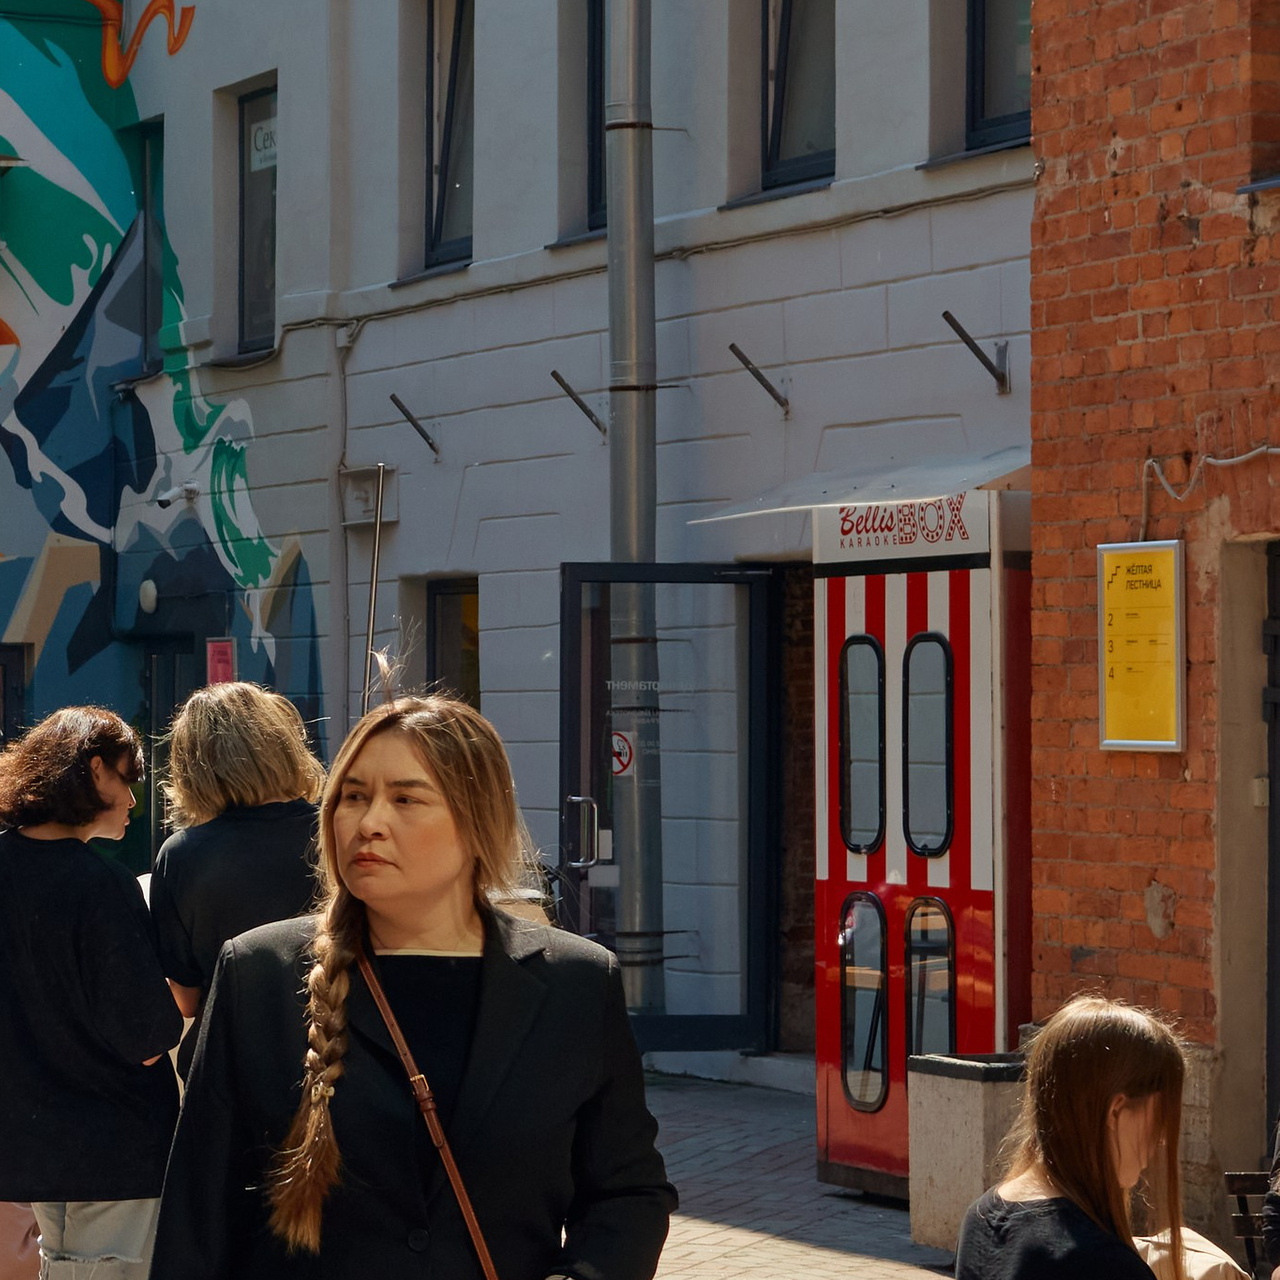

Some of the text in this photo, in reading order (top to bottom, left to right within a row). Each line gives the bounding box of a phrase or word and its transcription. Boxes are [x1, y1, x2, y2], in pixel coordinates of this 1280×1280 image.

[839, 491, 969, 545] Bellis BOX
[840, 534, 897, 549] KARAOKE
[1126, 564, 1153, 575] ЖЁЛТАЯ
[1126, 579, 1161, 591] ЛЕСТНИЦА
[1108, 613, 1113, 626] 2
[1108, 640, 1113, 653] 3
[1108, 667, 1114, 680] 4
